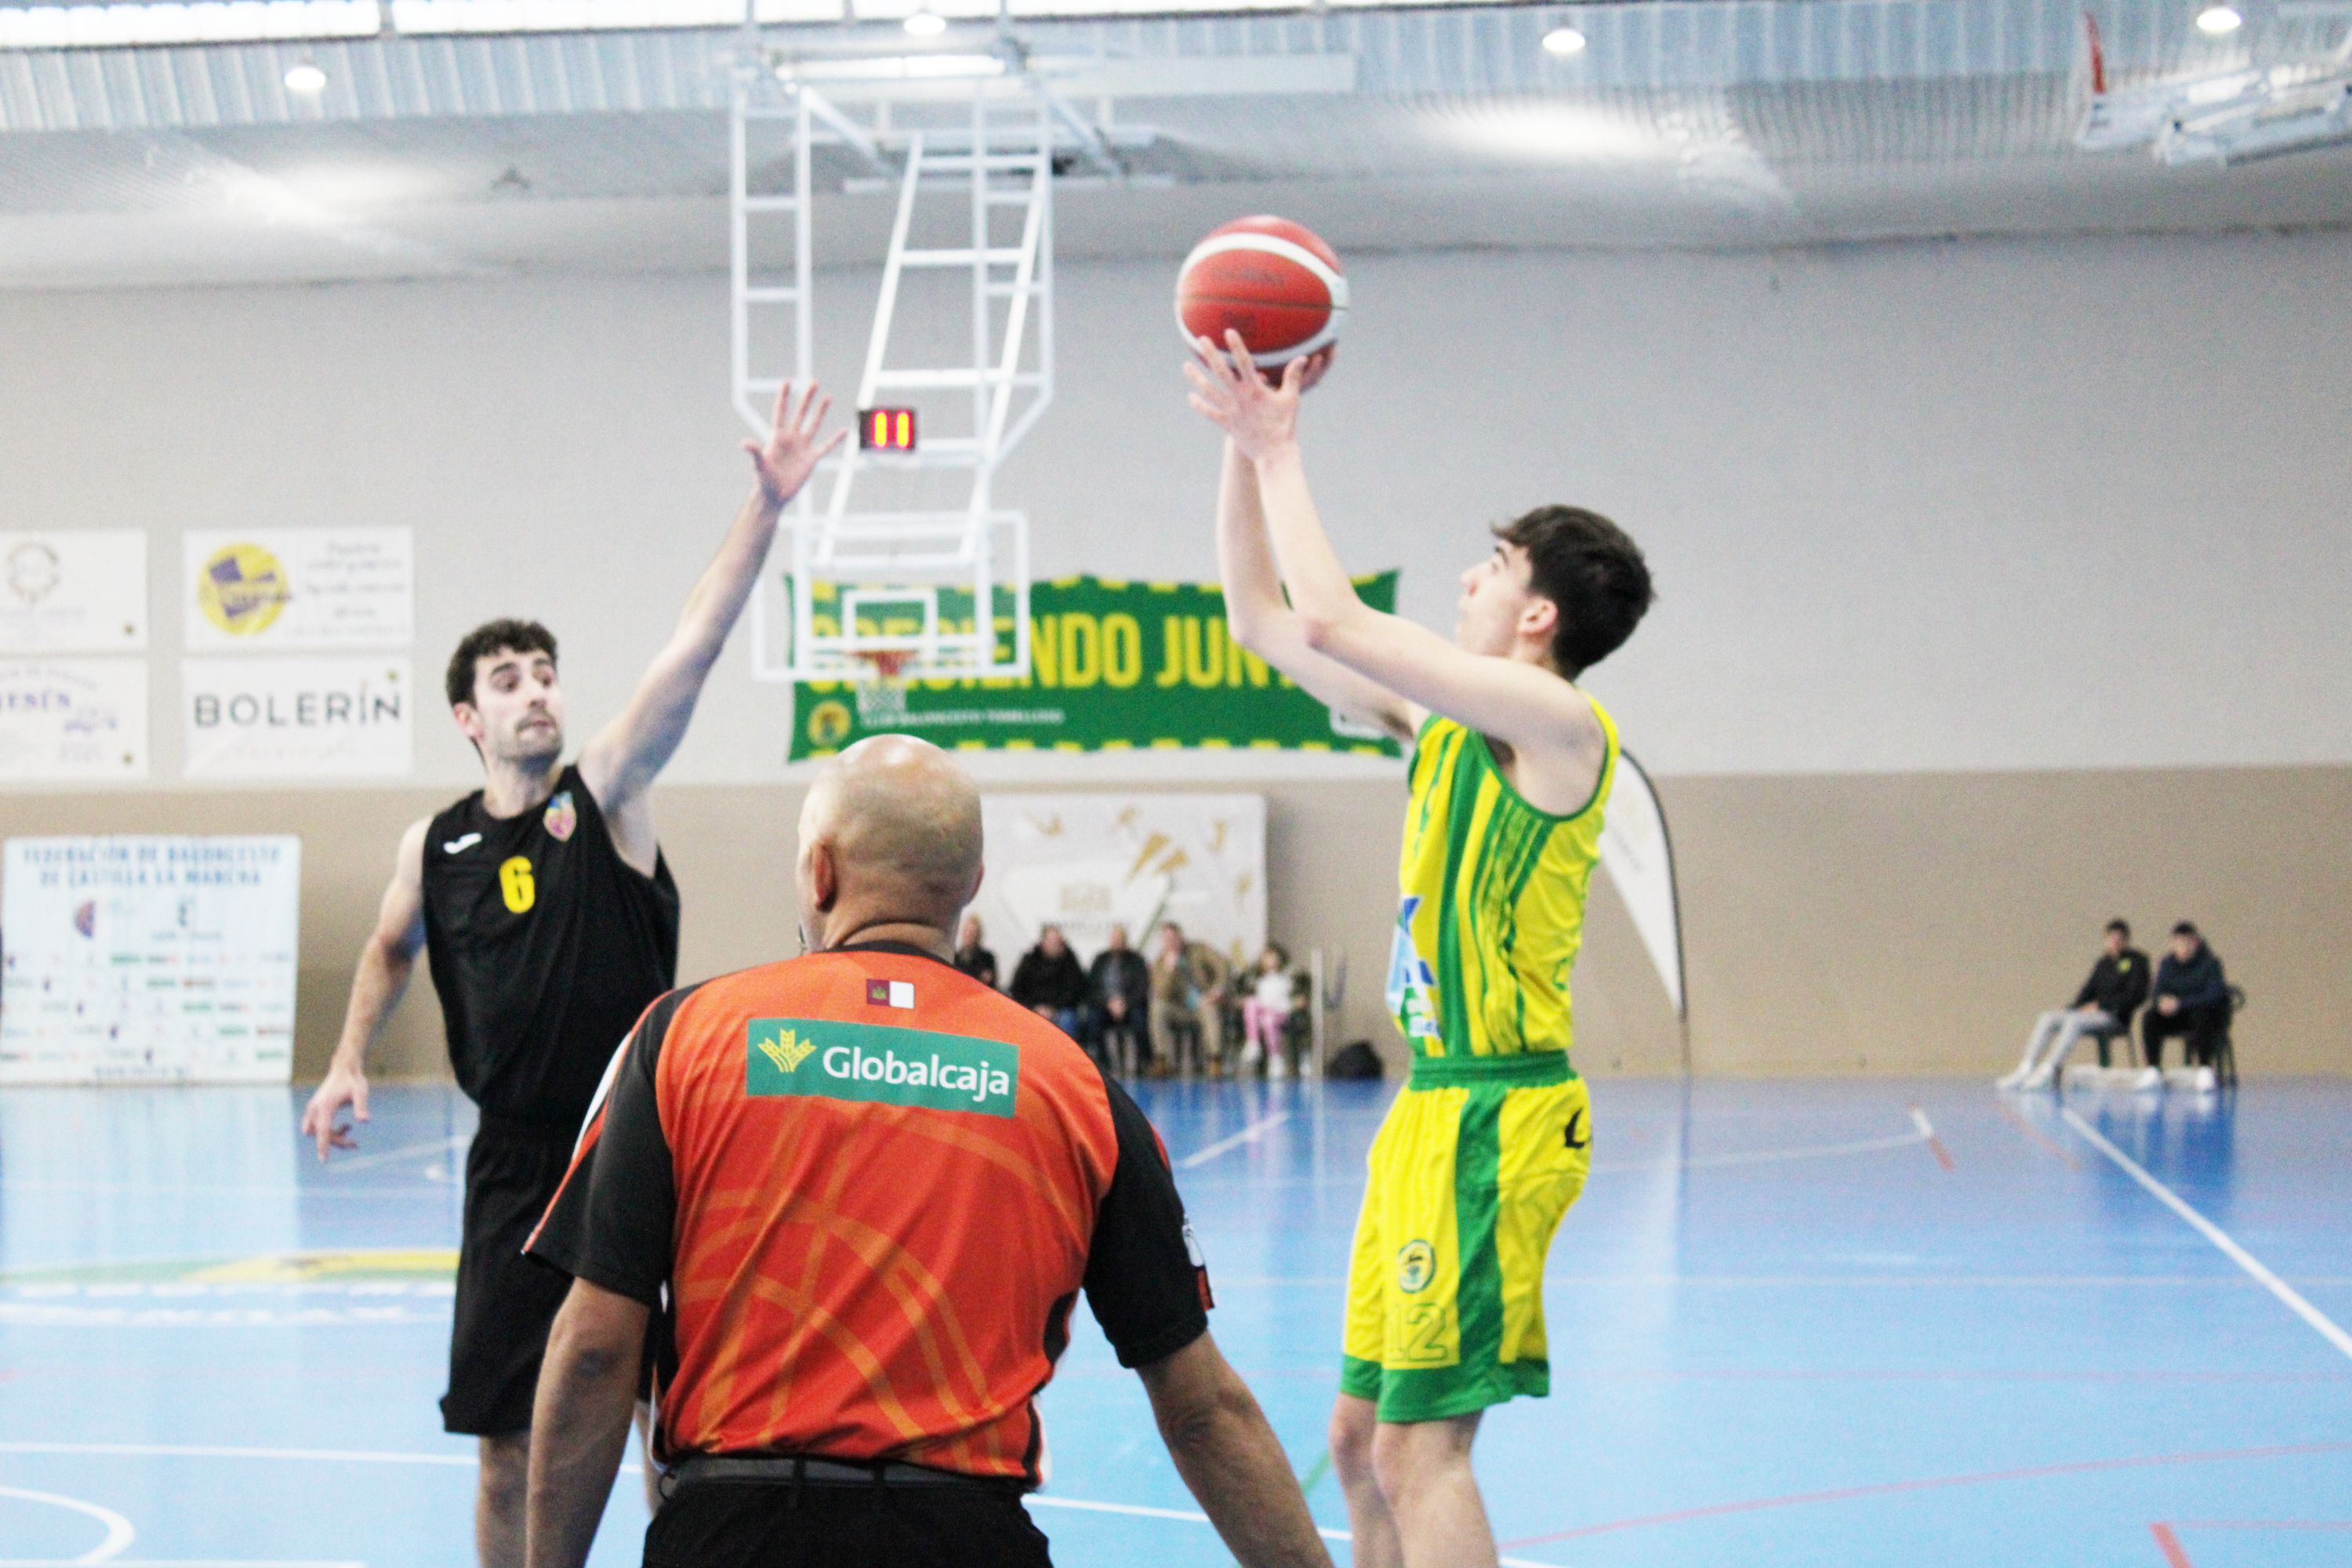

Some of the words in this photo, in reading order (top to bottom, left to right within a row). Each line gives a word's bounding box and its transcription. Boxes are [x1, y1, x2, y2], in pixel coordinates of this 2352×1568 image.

[873, 410, 912, 448] 11
[1156, 615, 1294, 688] JUN
[194, 679, 401, 728] BOLERÍN
[499, 856, 535, 913] 6
[822, 1046, 1009, 1102] Globalcaja
